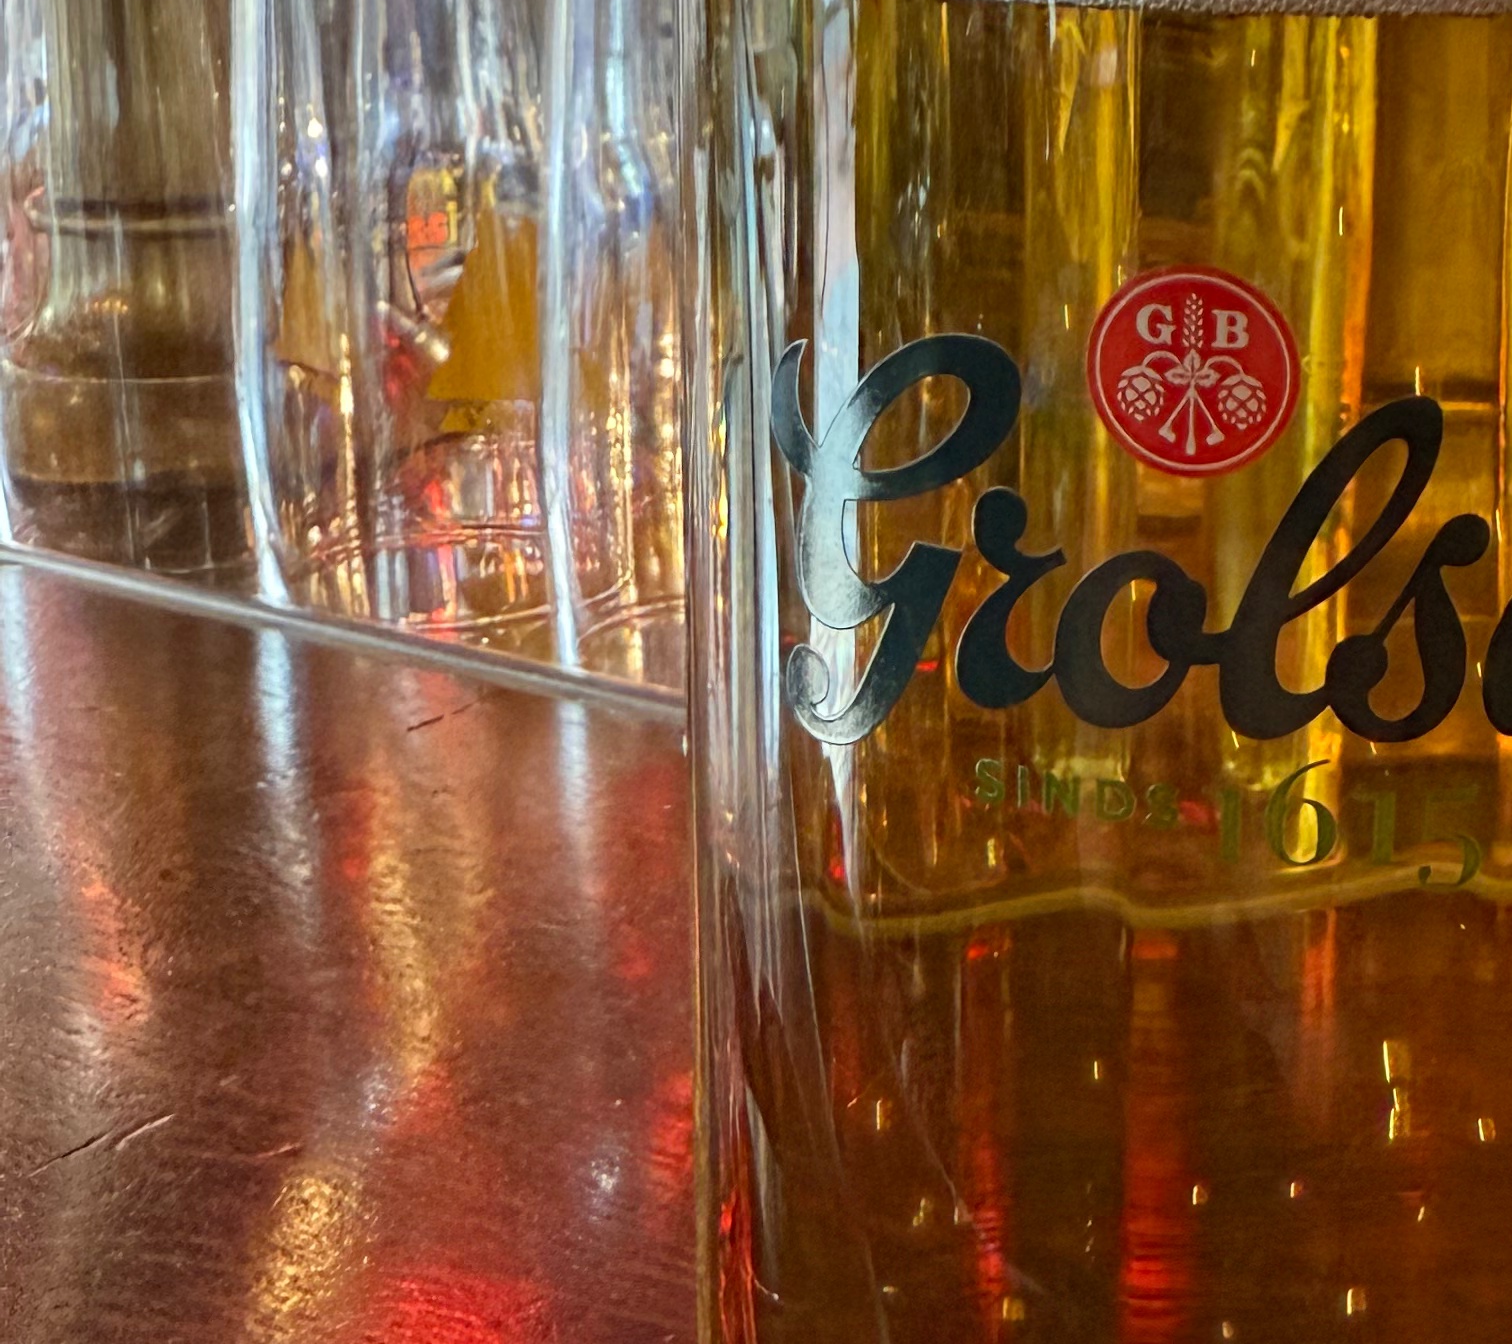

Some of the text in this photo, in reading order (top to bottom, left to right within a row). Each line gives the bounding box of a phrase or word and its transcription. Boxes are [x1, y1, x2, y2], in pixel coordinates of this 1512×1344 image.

[1136, 304, 1249, 348] G B
[975, 758, 1483, 888] SINDS 1615
